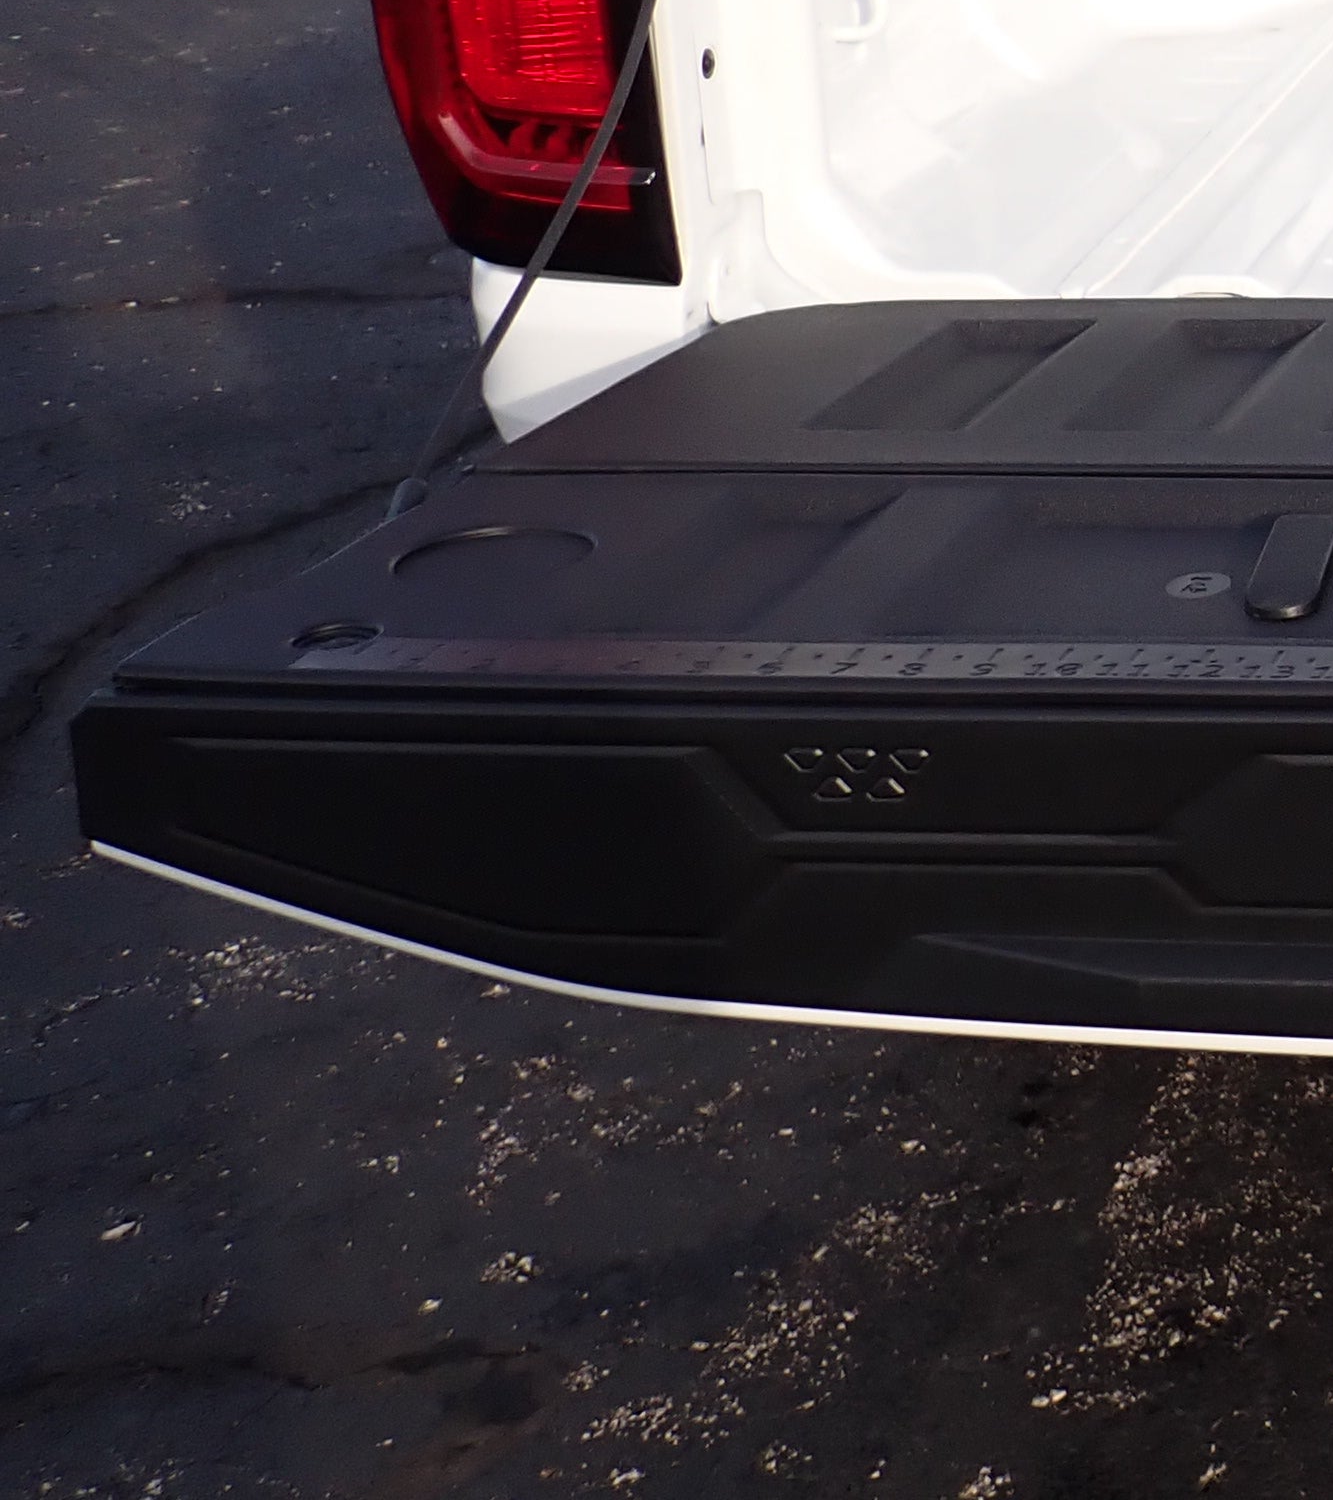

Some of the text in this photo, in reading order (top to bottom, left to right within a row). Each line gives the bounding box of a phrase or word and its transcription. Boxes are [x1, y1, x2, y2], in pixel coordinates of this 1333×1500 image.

[831, 661, 859, 675] 7
[898, 662, 927, 676] 8
[969, 663, 999, 677] 9
[1024, 663, 1083, 676] 10
[1166, 664, 1224, 678] 12
[1239, 665, 1295, 679] 13
